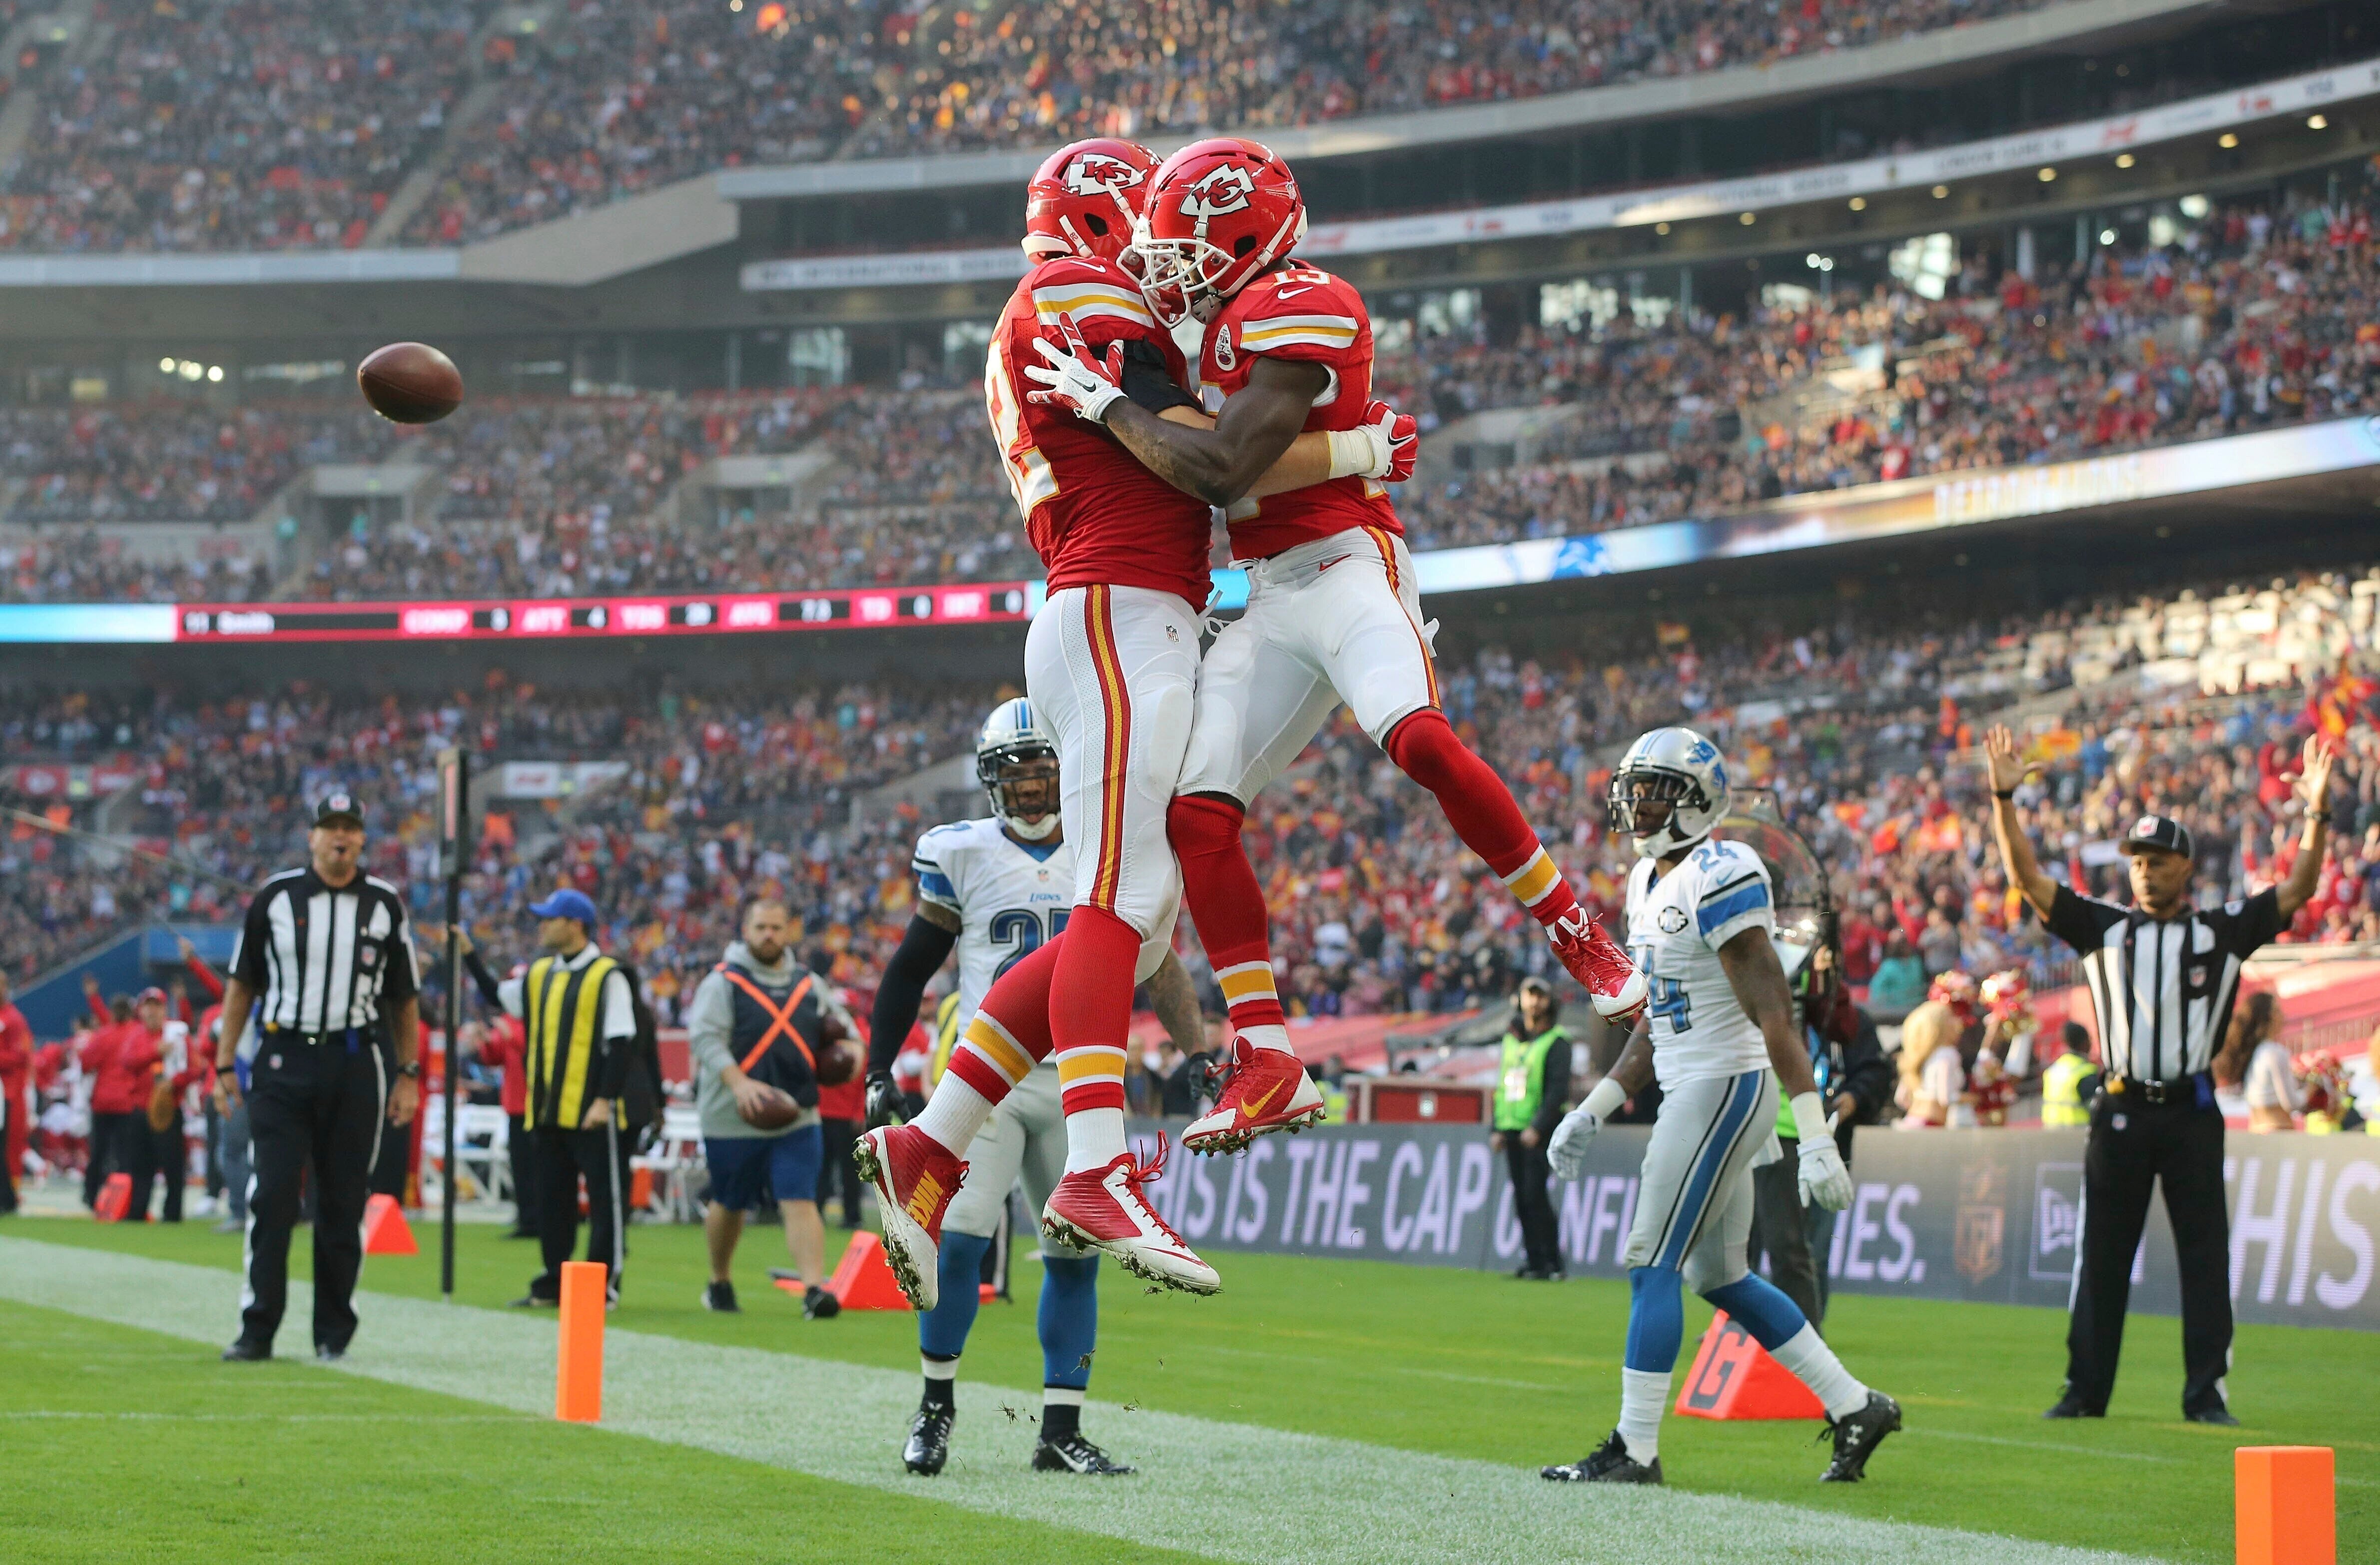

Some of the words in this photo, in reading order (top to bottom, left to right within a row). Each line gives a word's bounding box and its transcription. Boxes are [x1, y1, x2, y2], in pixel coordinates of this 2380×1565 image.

[1082, 161, 1131, 187] KC
[1191, 177, 1244, 210] KC
[1070, 232, 1078, 241] 82
[1273, 270, 1331, 286] 13
[1692, 841, 1739, 872] 24
[990, 908, 1073, 985] 2
[905, 1169, 944, 1229] NIKE
[1221, 1138, 1274, 1243] IS
[1280, 1138, 1381, 1248] THE
[1382, 1140, 1491, 1255] CAP
[2224, 1157, 2380, 1310] HIS
[1688, 1320, 1749, 1410] G
